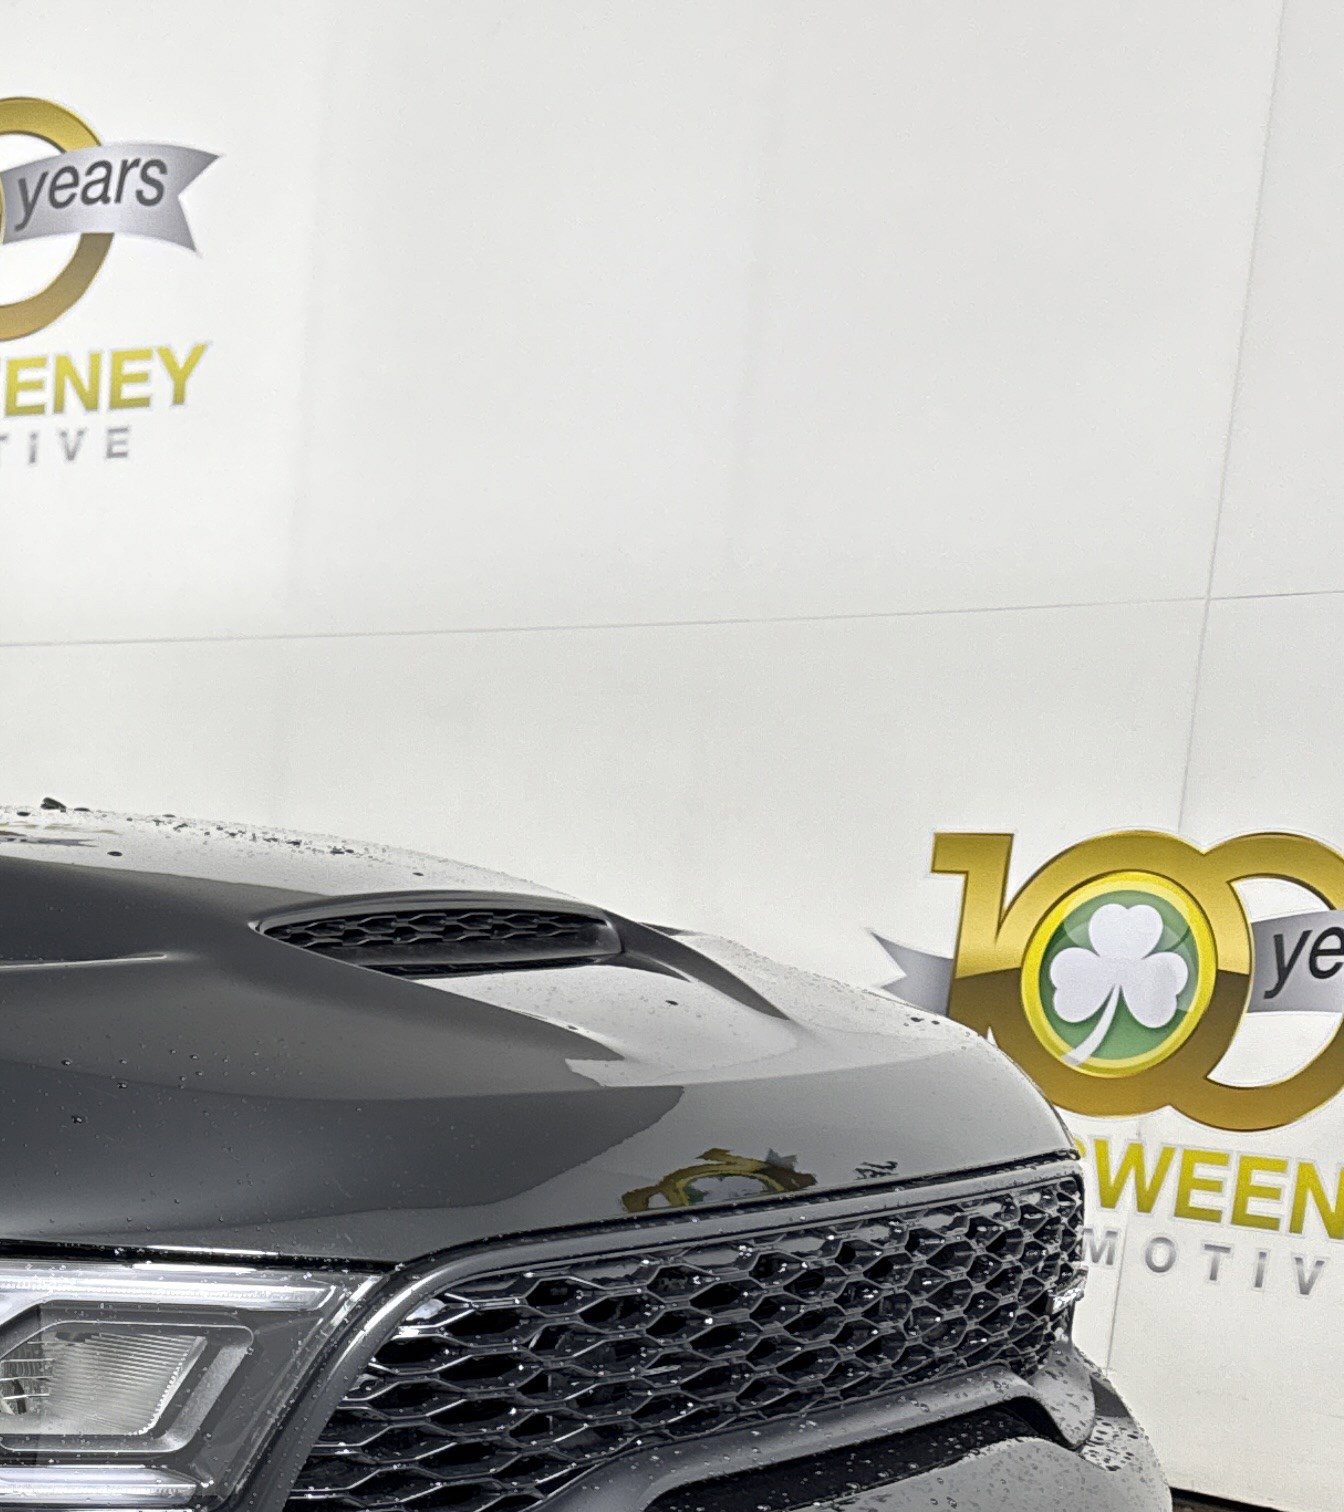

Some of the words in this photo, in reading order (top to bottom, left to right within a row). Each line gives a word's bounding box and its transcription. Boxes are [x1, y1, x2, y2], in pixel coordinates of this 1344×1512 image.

[15, 156, 168, 230] years
[1078, 1136, 1344, 1241] WEEN
[1082, 1227, 1326, 1296] MOTIV
